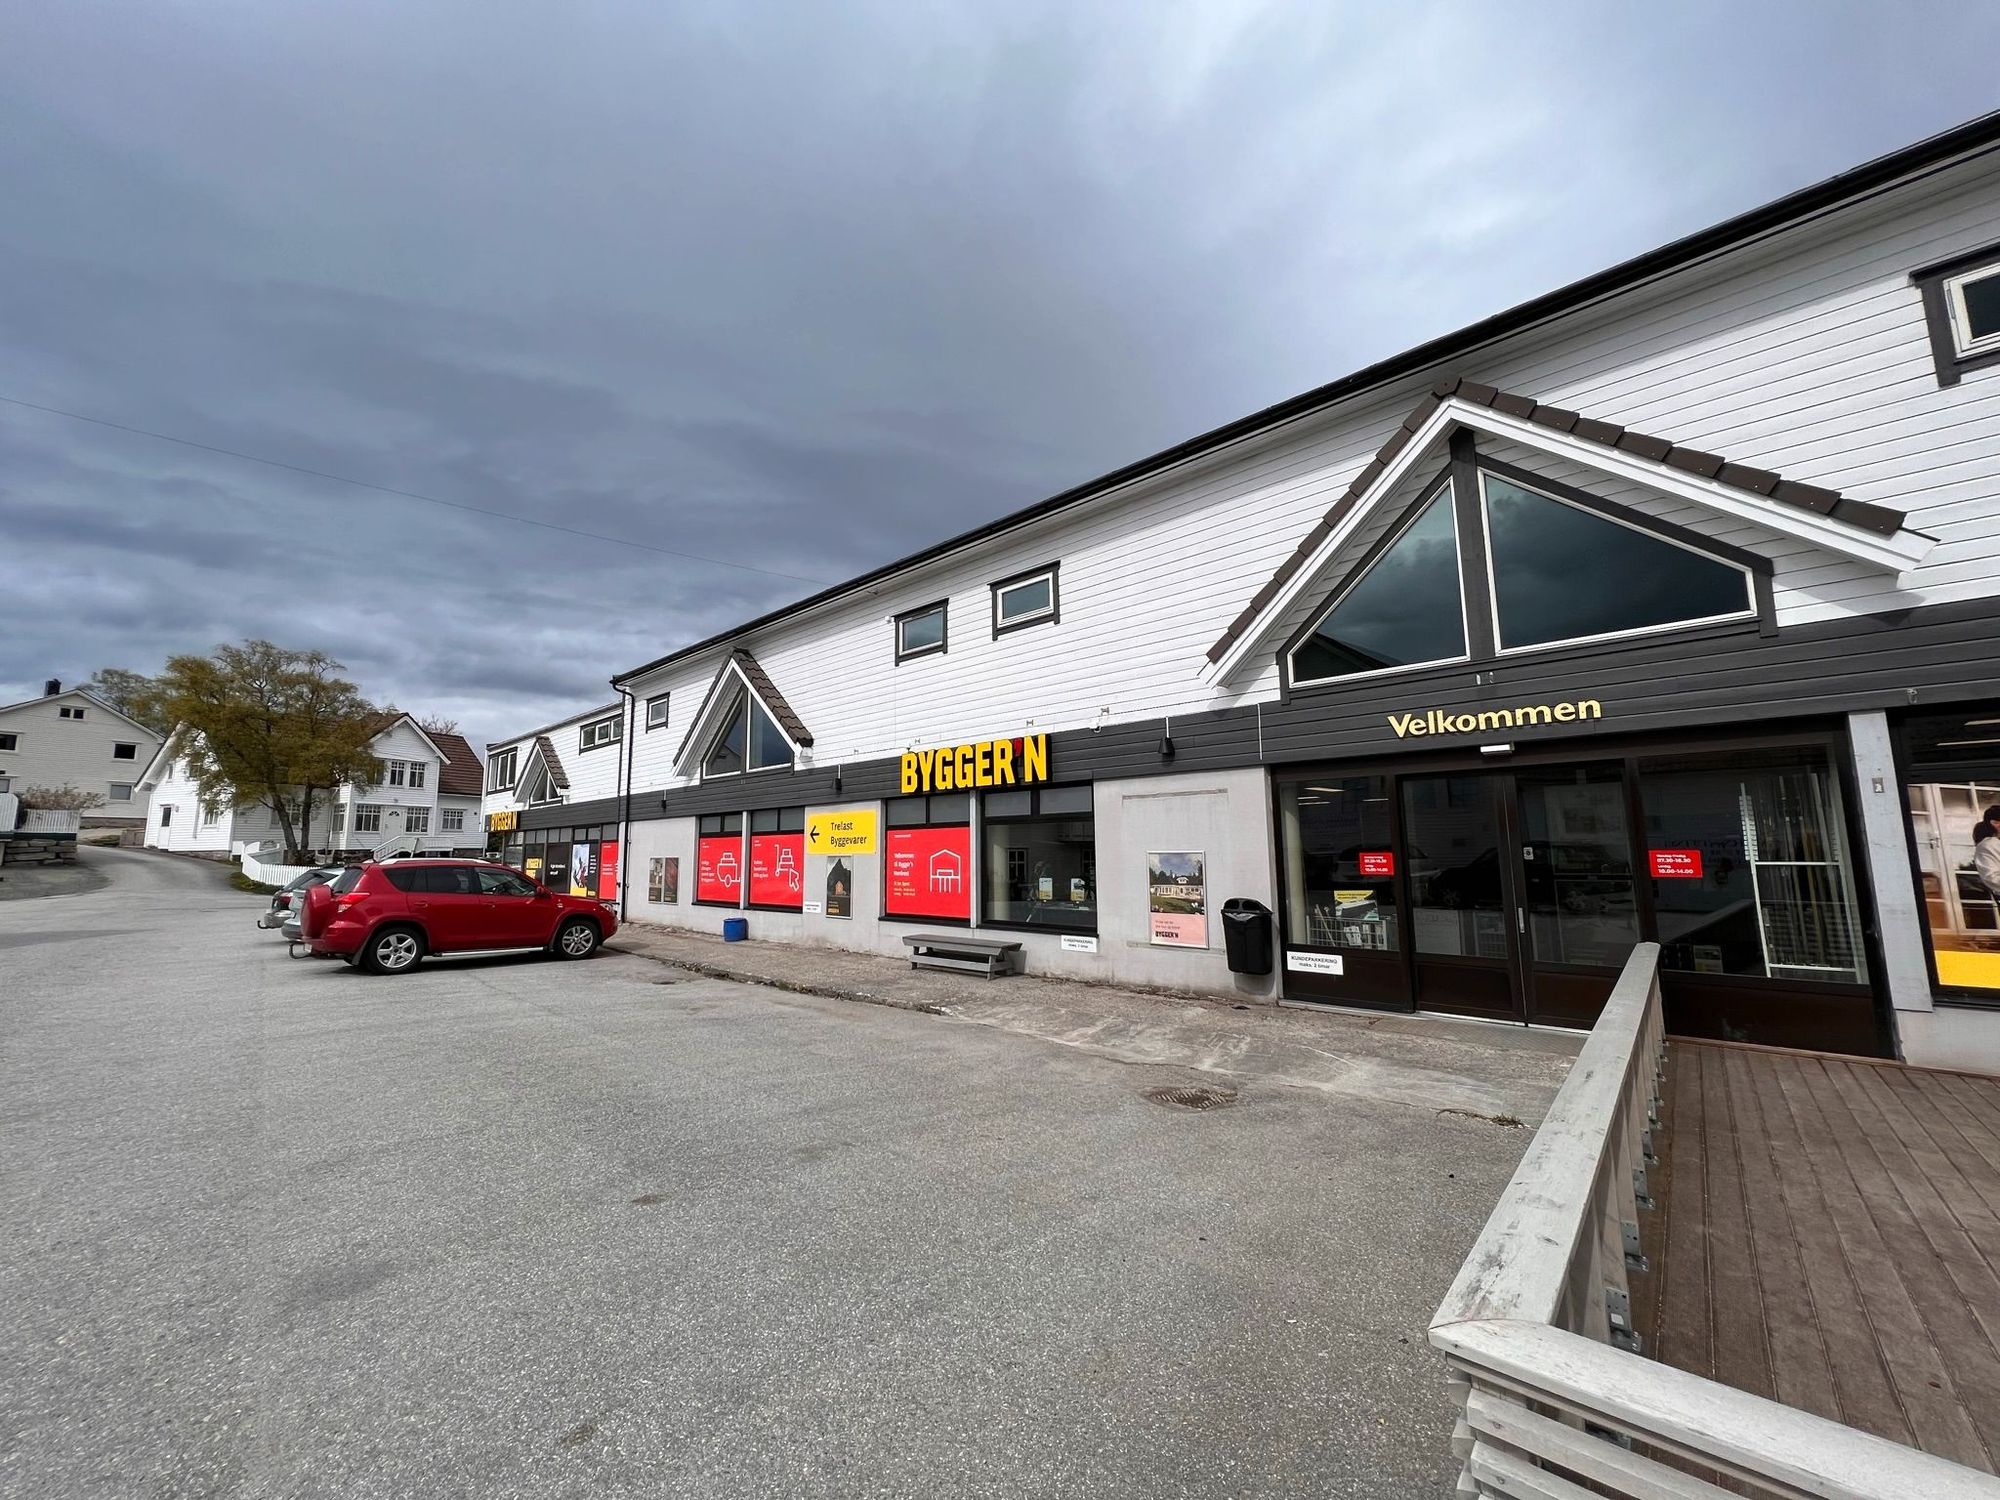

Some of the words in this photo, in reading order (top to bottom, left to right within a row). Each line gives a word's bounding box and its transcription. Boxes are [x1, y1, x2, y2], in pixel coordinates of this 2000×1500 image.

[1387, 698, 1602, 739] Velkommen
[901, 733, 1047, 794] BYGGER'N
[831, 821, 854, 831] Trelast
[830, 836, 868, 848] Byggevarer
[1291, 955, 1338, 964] KUNDEPARKERING
